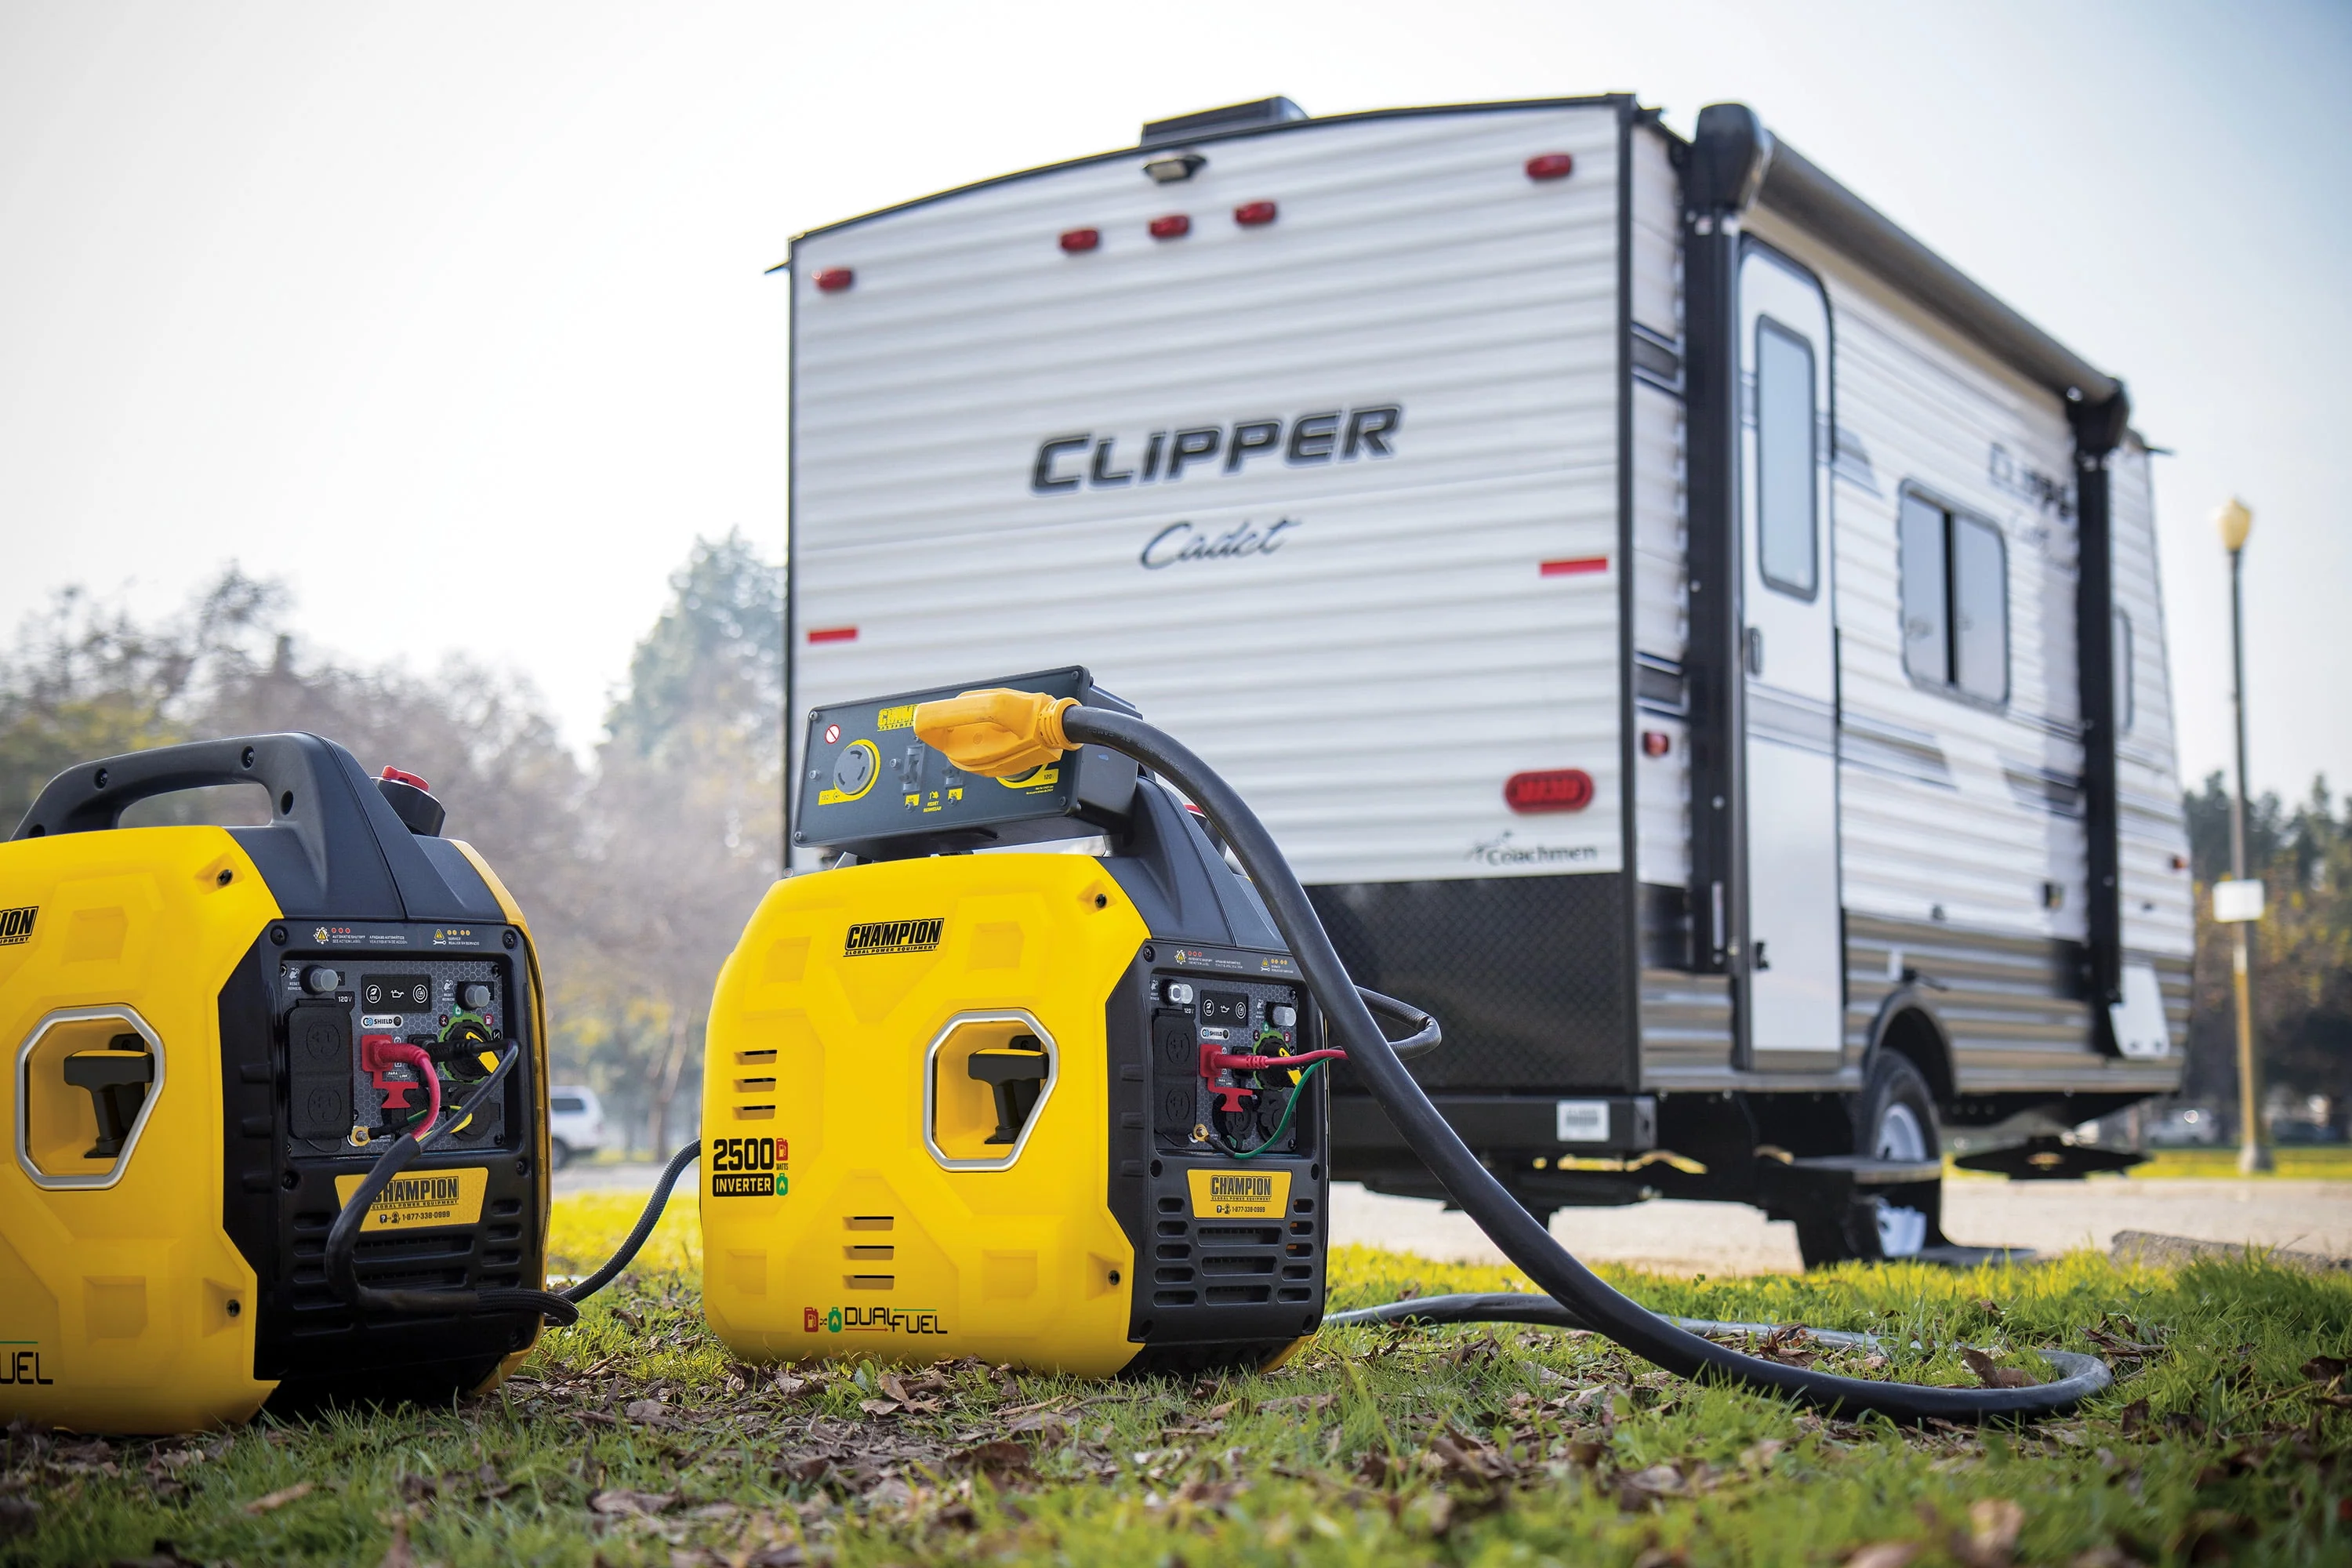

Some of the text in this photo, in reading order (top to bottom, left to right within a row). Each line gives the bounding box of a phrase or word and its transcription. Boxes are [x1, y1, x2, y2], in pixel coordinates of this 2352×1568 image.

[1031, 404, 1402, 495] CLIPPER
[1140, 514, 1301, 570] Cadet
[1486, 843, 1598, 866] Coachmen
[845, 918, 944, 950] CHAMPION
[713, 1138, 775, 1171] 2500
[716, 1178, 771, 1192] INVERTER
[1211, 1175, 1272, 1196] CHAMPION
[844, 1307, 948, 1334] DUAL FUEL
